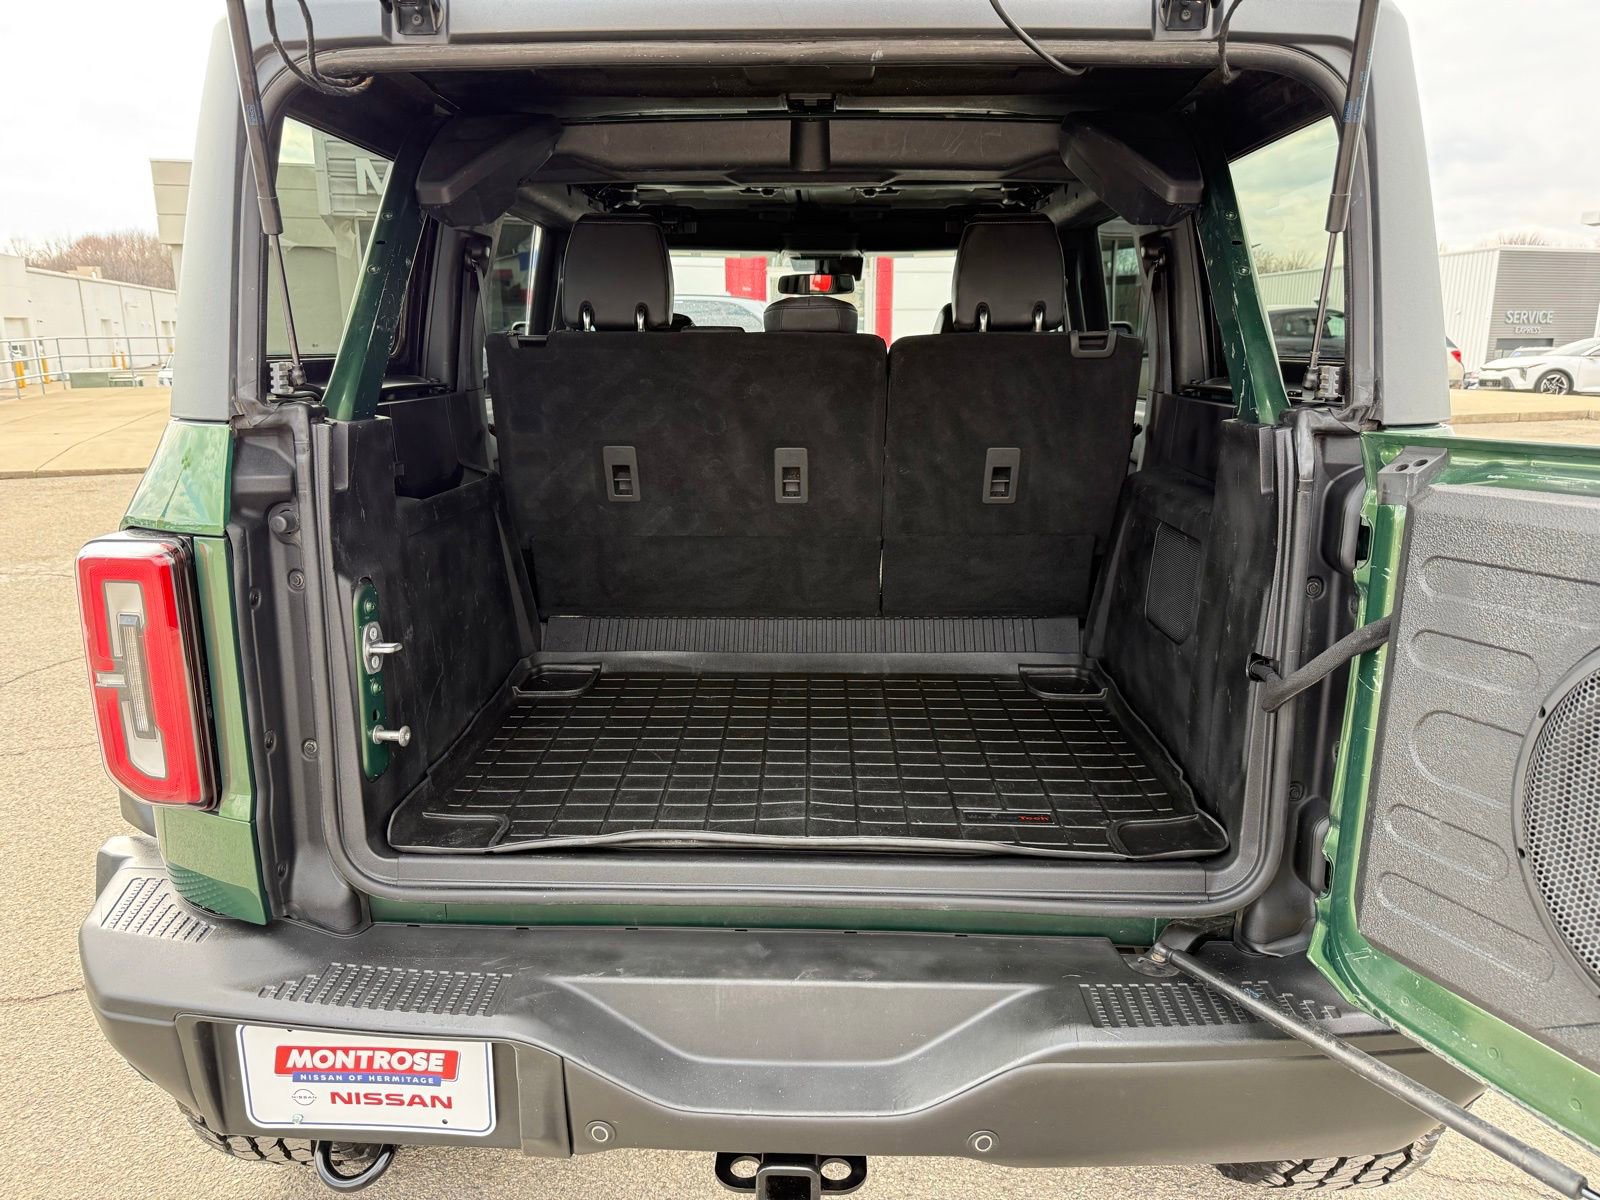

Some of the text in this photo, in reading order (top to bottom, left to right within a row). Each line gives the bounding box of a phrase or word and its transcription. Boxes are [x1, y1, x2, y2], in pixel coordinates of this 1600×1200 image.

[1505, 310, 1555, 324] SERVICE
[1514, 326, 1541, 334] EXPRESS
[286, 1049, 445, 1072] MONTROSE
[368, 1075, 434, 1084] HERMITAGE
[330, 1092, 452, 1109] NISSAN
